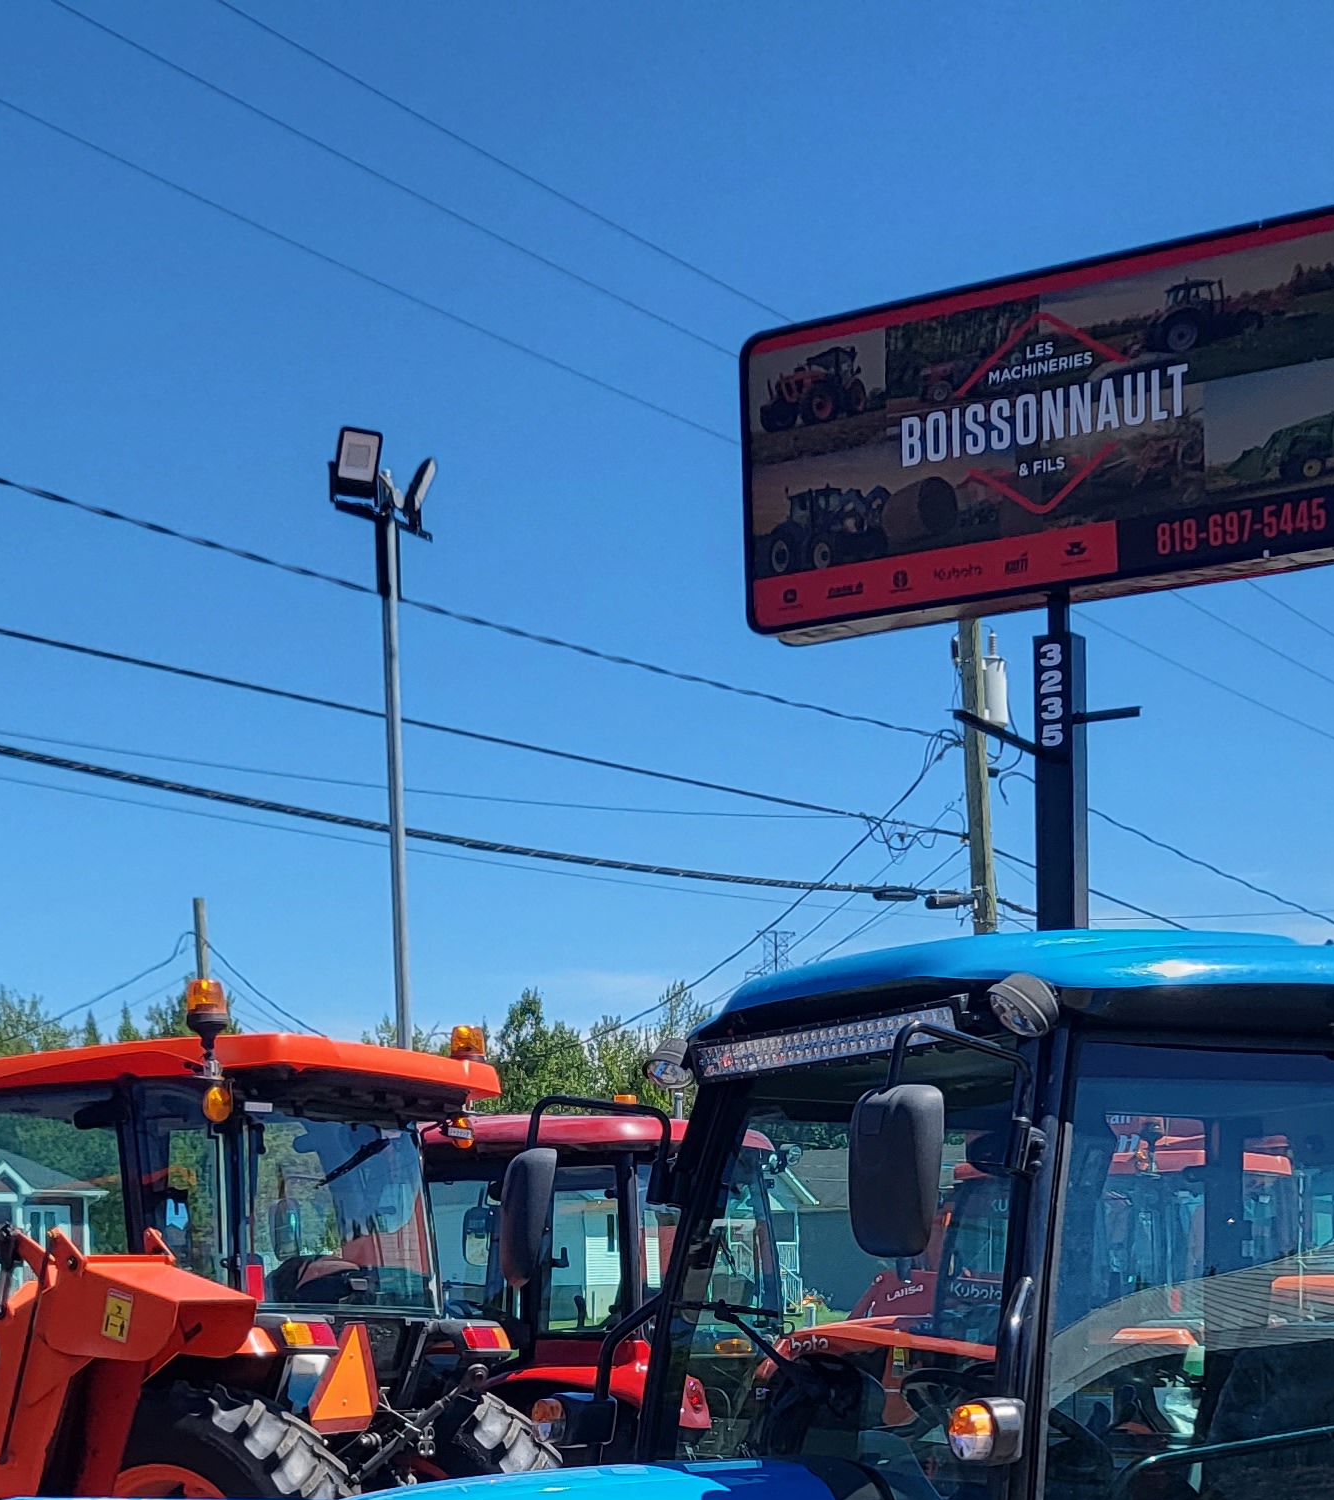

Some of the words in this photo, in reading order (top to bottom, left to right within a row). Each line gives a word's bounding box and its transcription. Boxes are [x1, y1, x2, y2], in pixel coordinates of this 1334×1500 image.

[1026, 341, 1054, 360] LES
[988, 352, 1093, 385] MACHINERIES
[901, 363, 1189, 468] BOISSONNAULT
[1019, 463, 1029, 477] &
[1033, 457, 1066, 474] FILS
[1156, 497, 1327, 555] 819-697-5445
[1039, 643, 1064, 747] 3235
[950, 1281, 1002, 1300] Kubota
